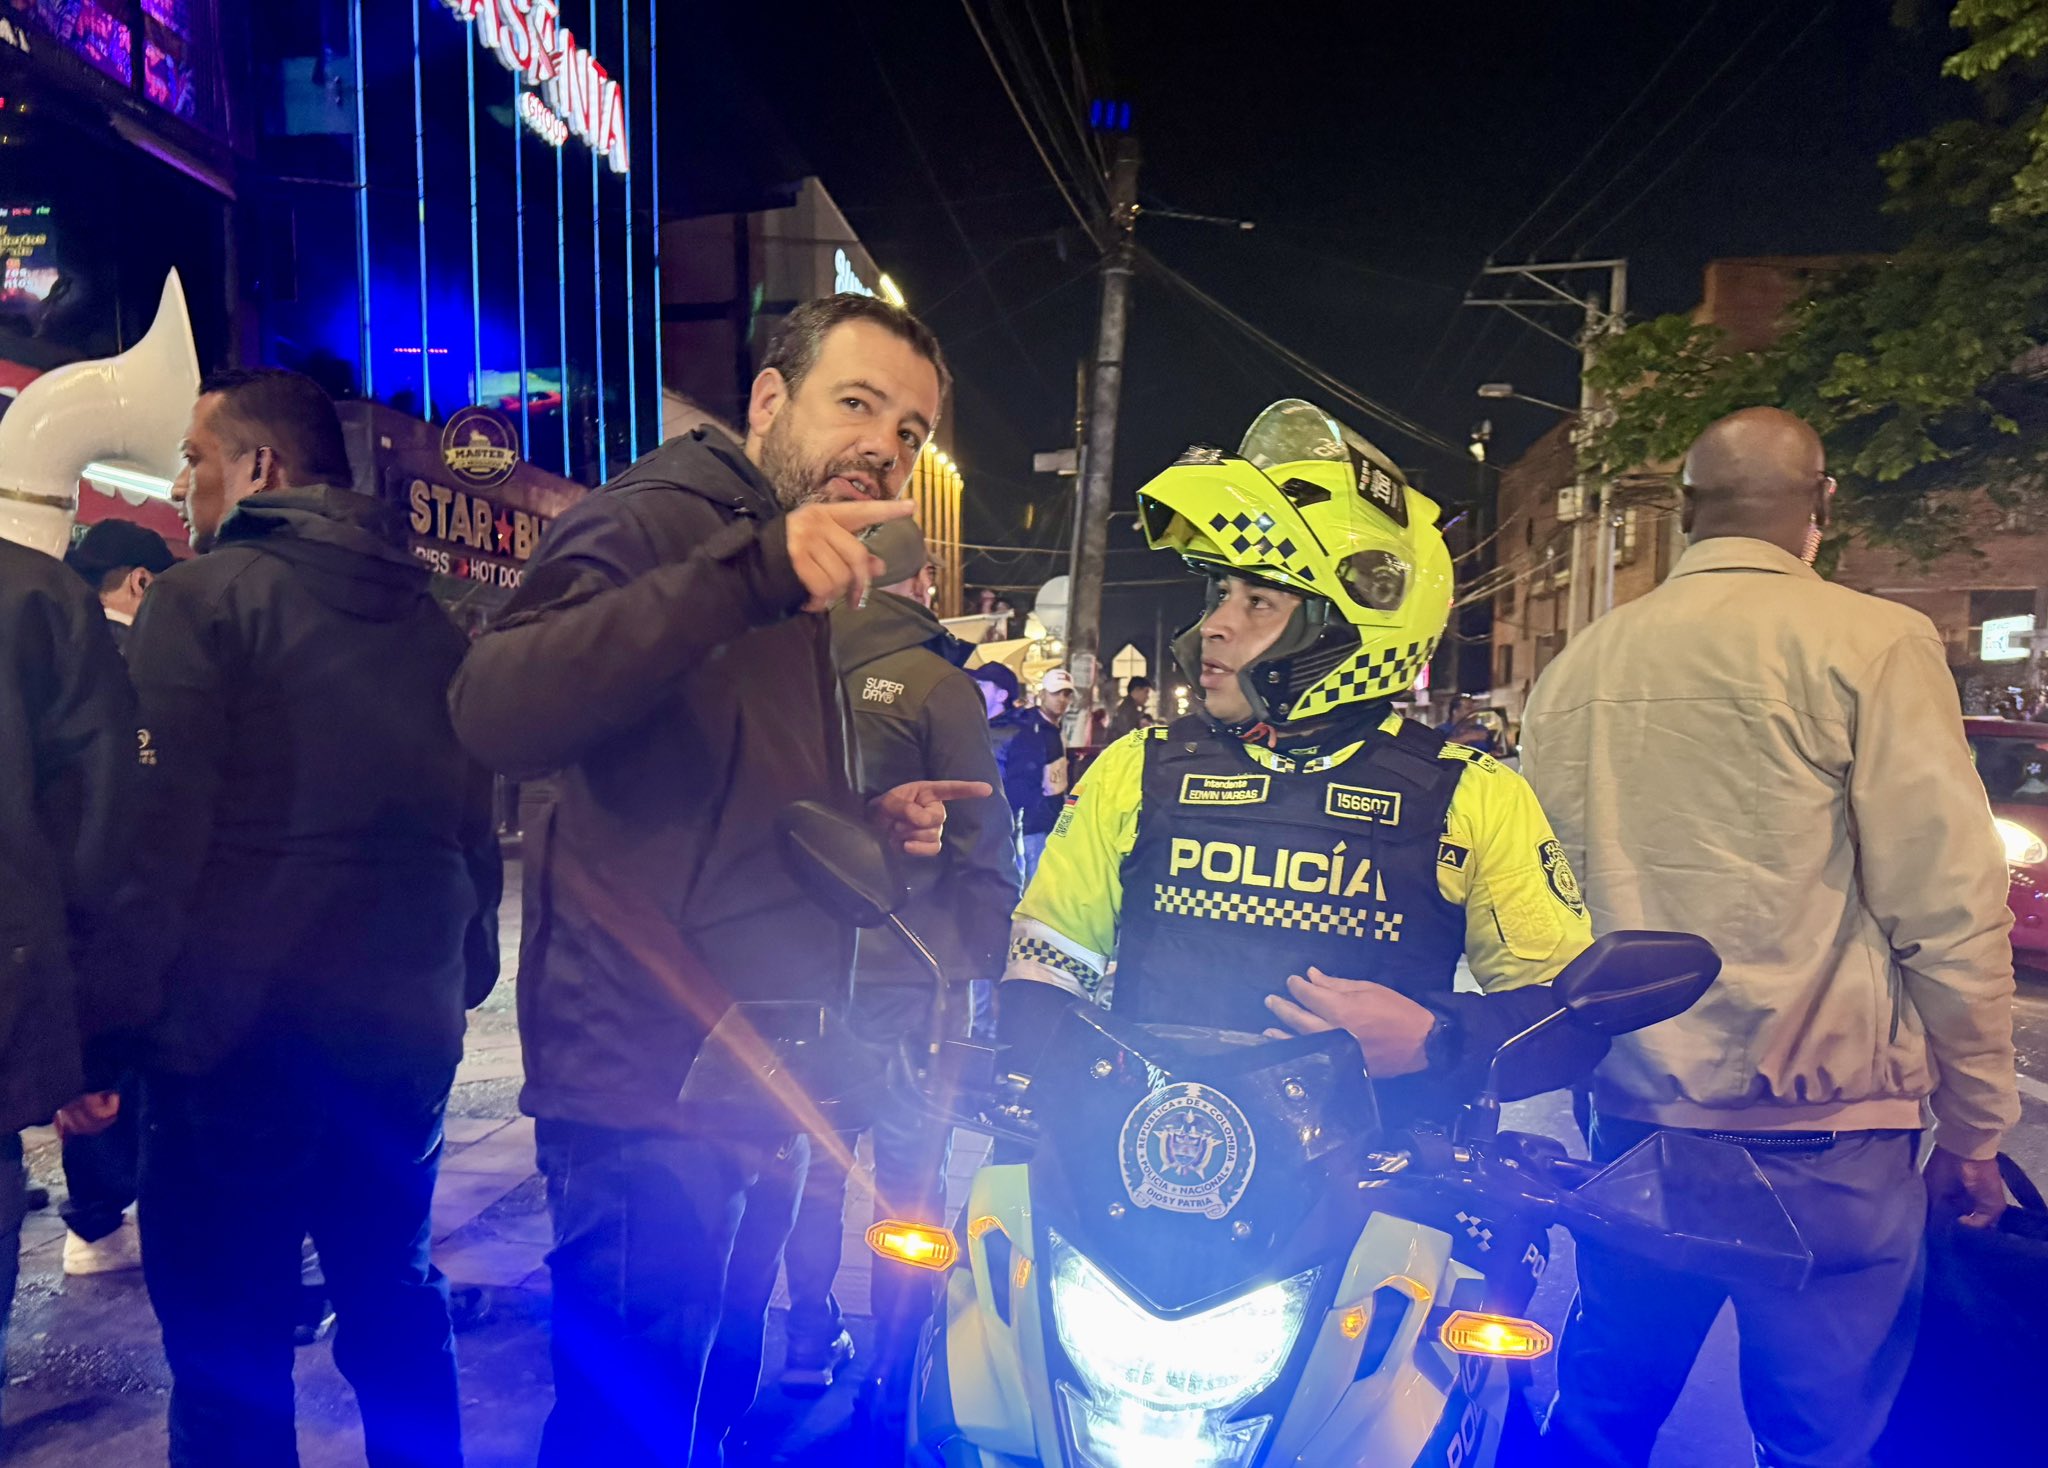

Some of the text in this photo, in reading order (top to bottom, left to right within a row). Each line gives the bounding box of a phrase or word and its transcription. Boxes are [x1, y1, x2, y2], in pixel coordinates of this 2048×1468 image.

[410, 479, 493, 551] STAR
[470, 558, 497, 584] HOT
[865, 677, 905, 695] SUPER
[1189, 788, 1259, 800] EDWIN VARGAS
[1203, 778, 1248, 789] Intendente
[1336, 792, 1390, 816] 156607
[1169, 837, 1387, 902] POLICÍA
[1185, 1098, 1201, 1107] DE
[1209, 1107, 1236, 1163] COLOMBIA
[1179, 1171, 1229, 1195] NACIONAL
[1177, 1197, 1214, 1208] PATRIA
